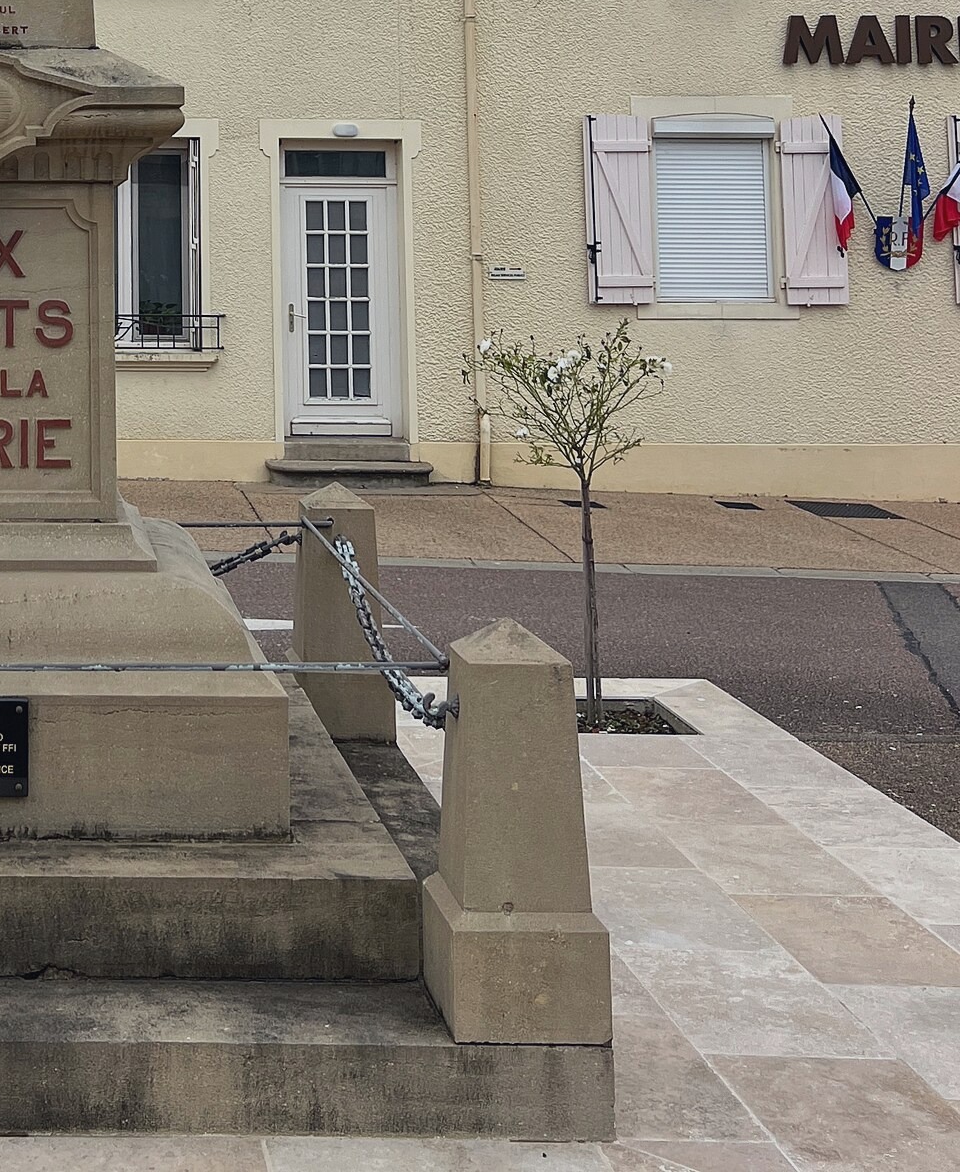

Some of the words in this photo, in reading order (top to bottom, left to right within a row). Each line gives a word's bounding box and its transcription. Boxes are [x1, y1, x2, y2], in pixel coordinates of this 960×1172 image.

[783, 15, 960, 65] MAIR
[0, 369, 49, 398] LA
[3, 744, 17, 752] FFI
